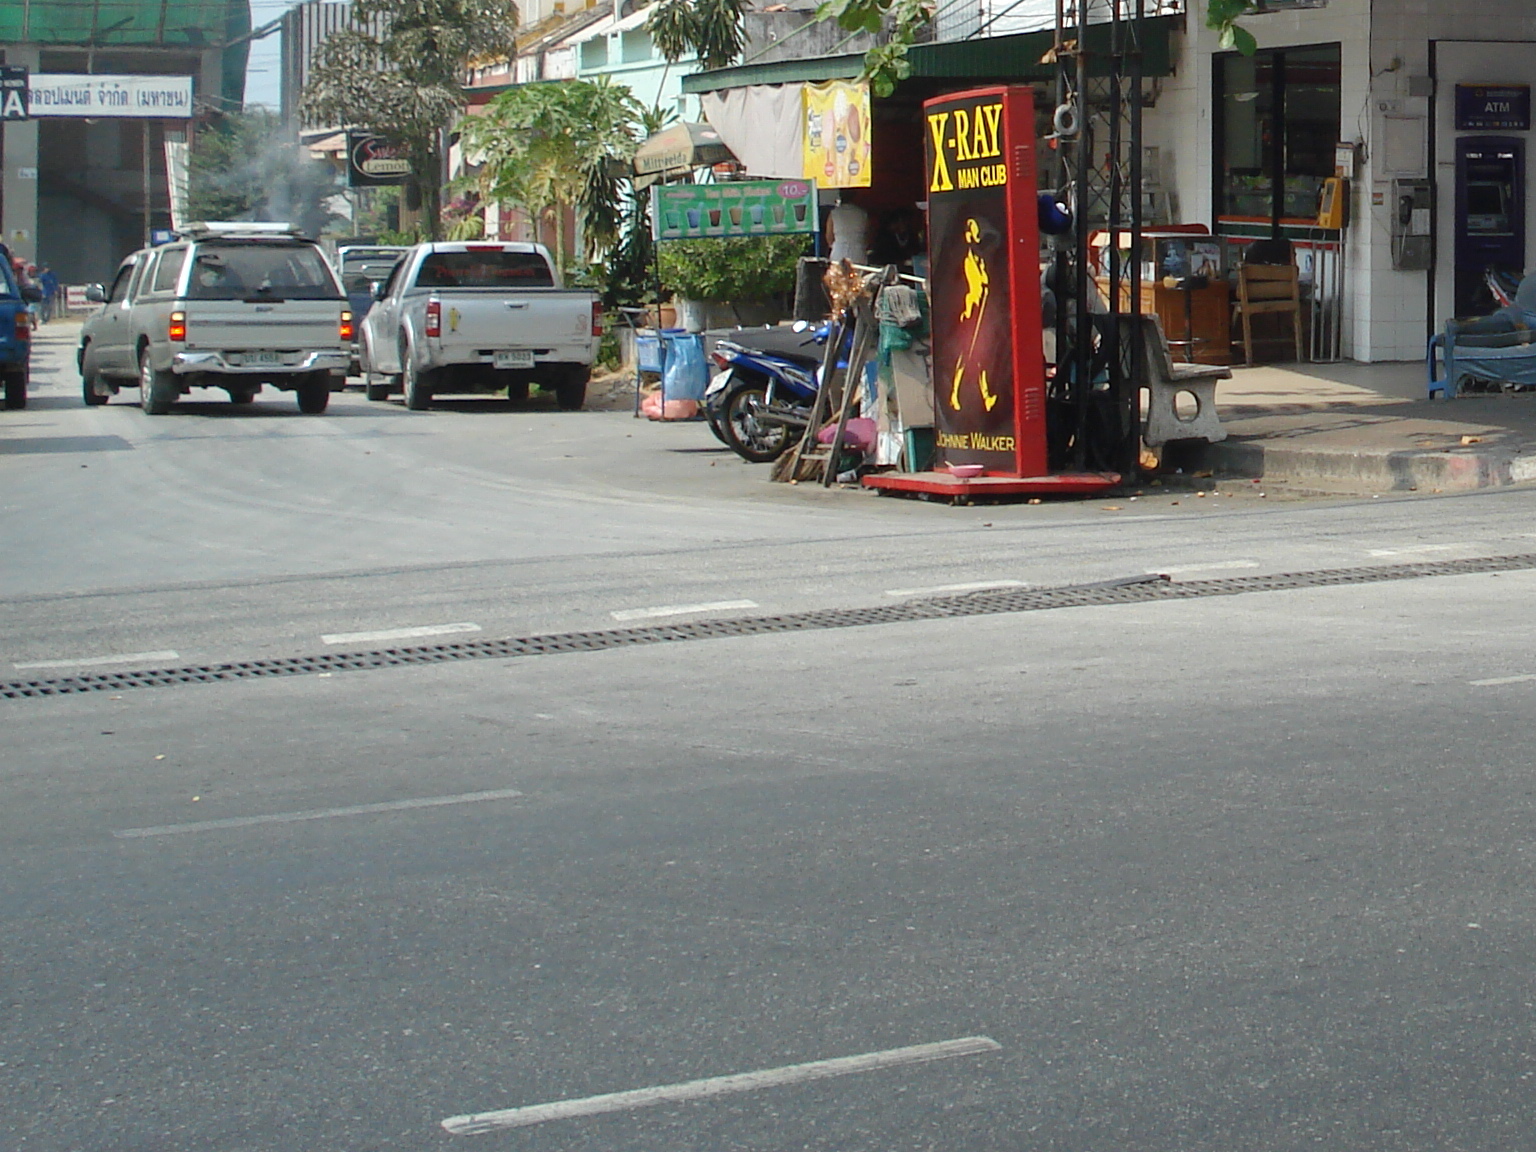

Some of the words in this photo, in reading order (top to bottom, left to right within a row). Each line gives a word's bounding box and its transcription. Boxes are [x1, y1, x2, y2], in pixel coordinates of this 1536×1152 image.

[1485, 101, 1510, 112] ATM
[927, 103, 1003, 193] X-RAY
[958, 167, 980, 190] MAN
[980, 163, 1007, 187] CLUB
[970, 432, 1014, 451] WALKER
